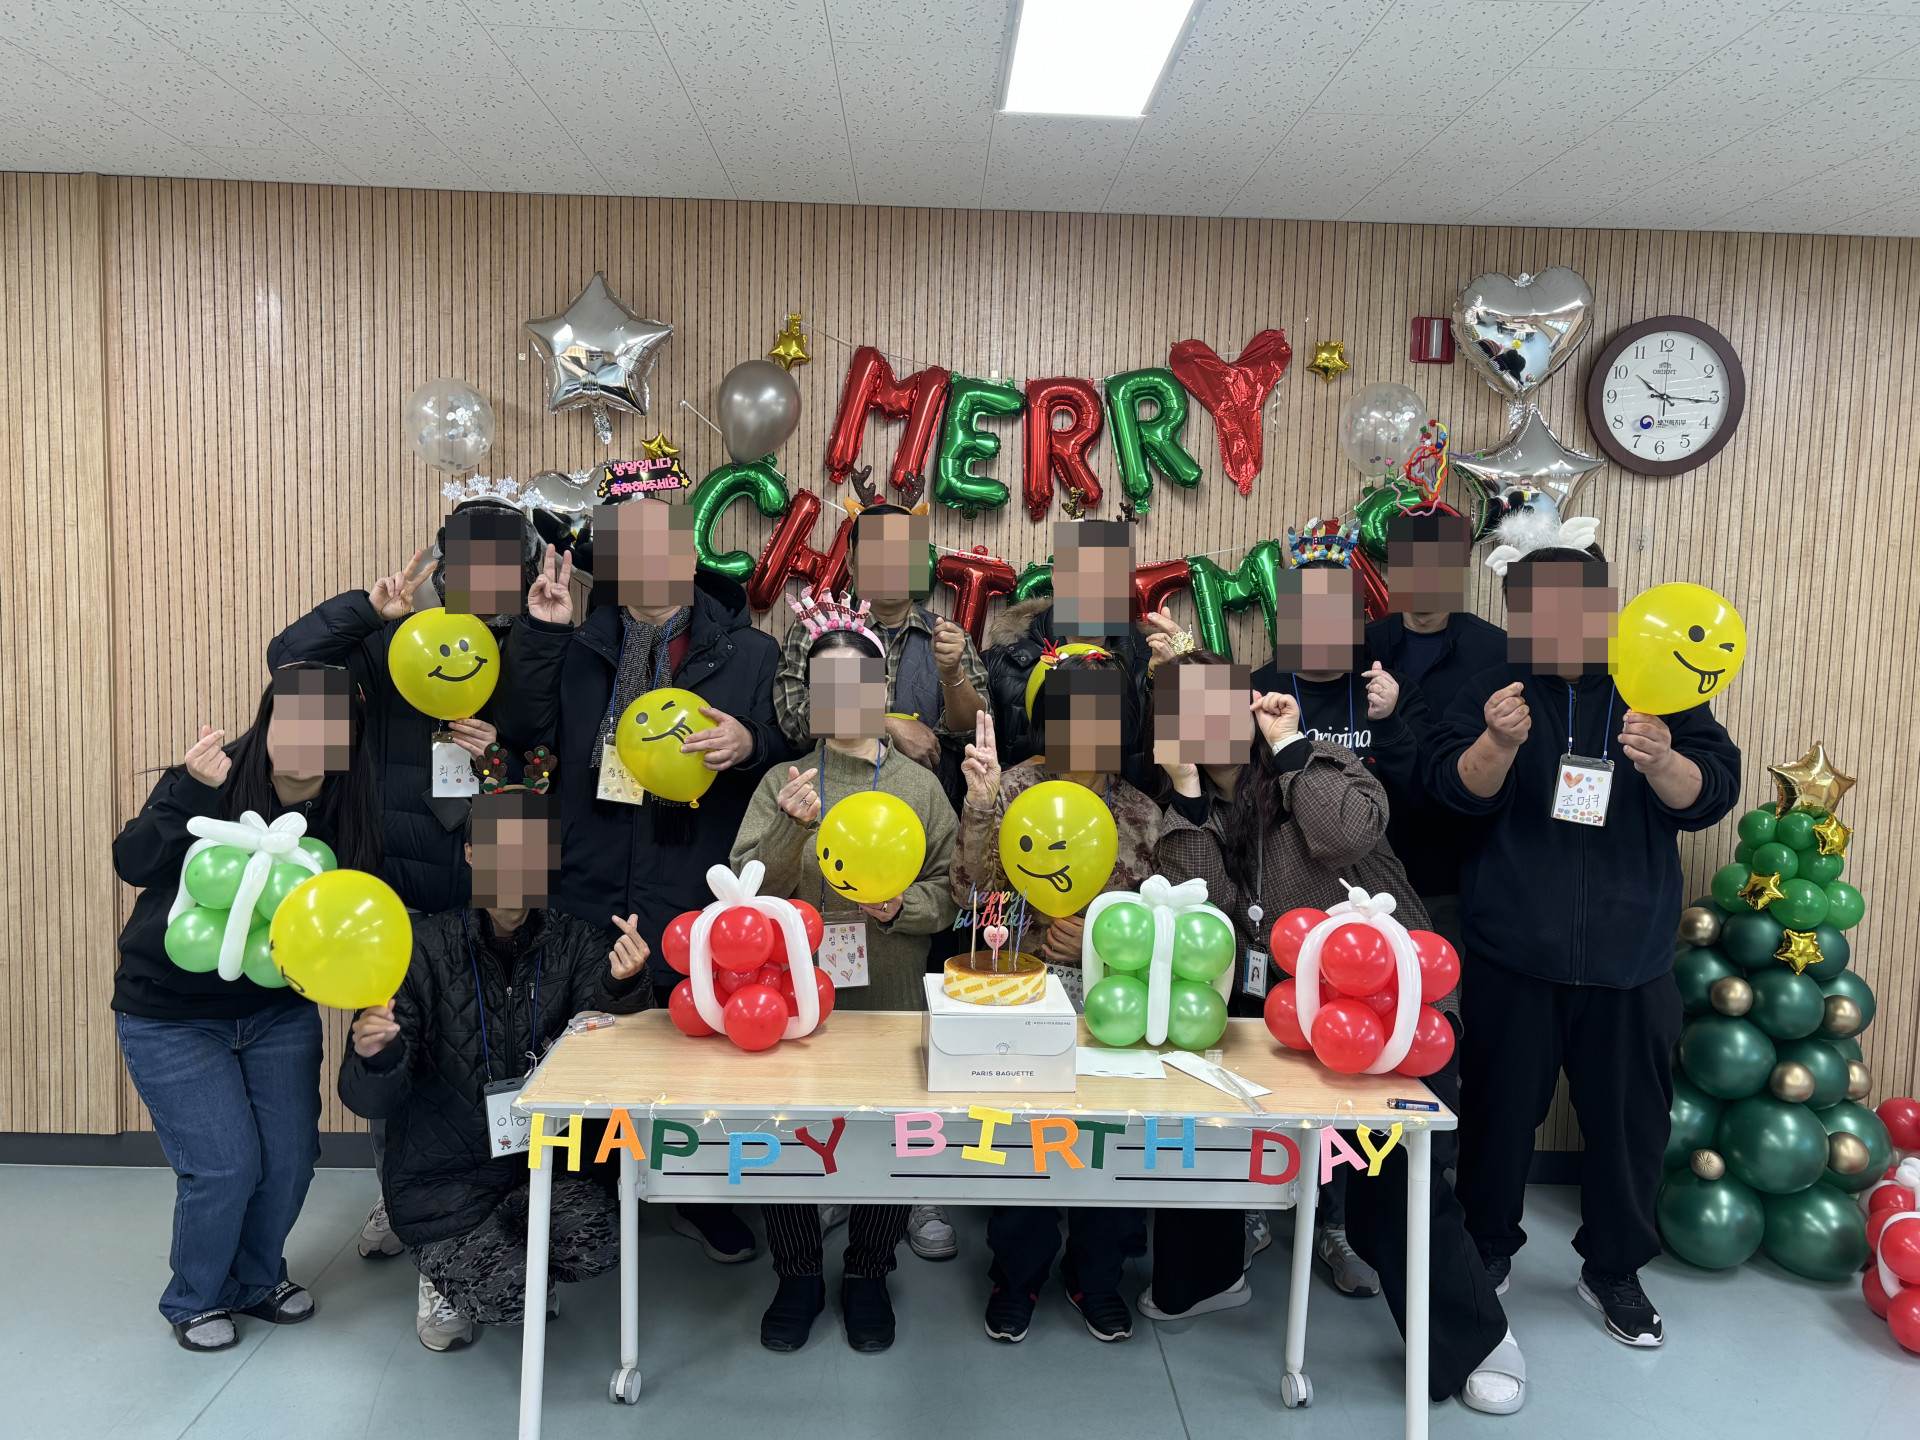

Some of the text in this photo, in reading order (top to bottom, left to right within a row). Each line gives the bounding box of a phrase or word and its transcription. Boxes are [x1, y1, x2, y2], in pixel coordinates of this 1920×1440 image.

[1634, 345, 1646, 360] 11
[1659, 338, 1675, 353] 12
[1689, 347, 1695, 361] 1
[1613, 365, 1628, 380] 10
[1703, 364, 1715, 379] 2
[1607, 389, 1617, 404] 9
[1708, 390, 1720, 405] 3
[829, 329, 1292, 519] MERRY
[1612, 415, 1624, 430] 8
[1699, 416, 1711, 430] 4
[1632, 434, 1642, 449] 7
[1654, 440, 1665, 455] 6
[1679, 434, 1691, 449] 5
[612, 457, 673, 477] 생일입니다
[609, 476, 681, 497] 축하해주세요
[967, 881, 1023, 914] happy
[953, 904, 1034, 937] birthday
[528, 1107, 846, 1185] HAPPY
